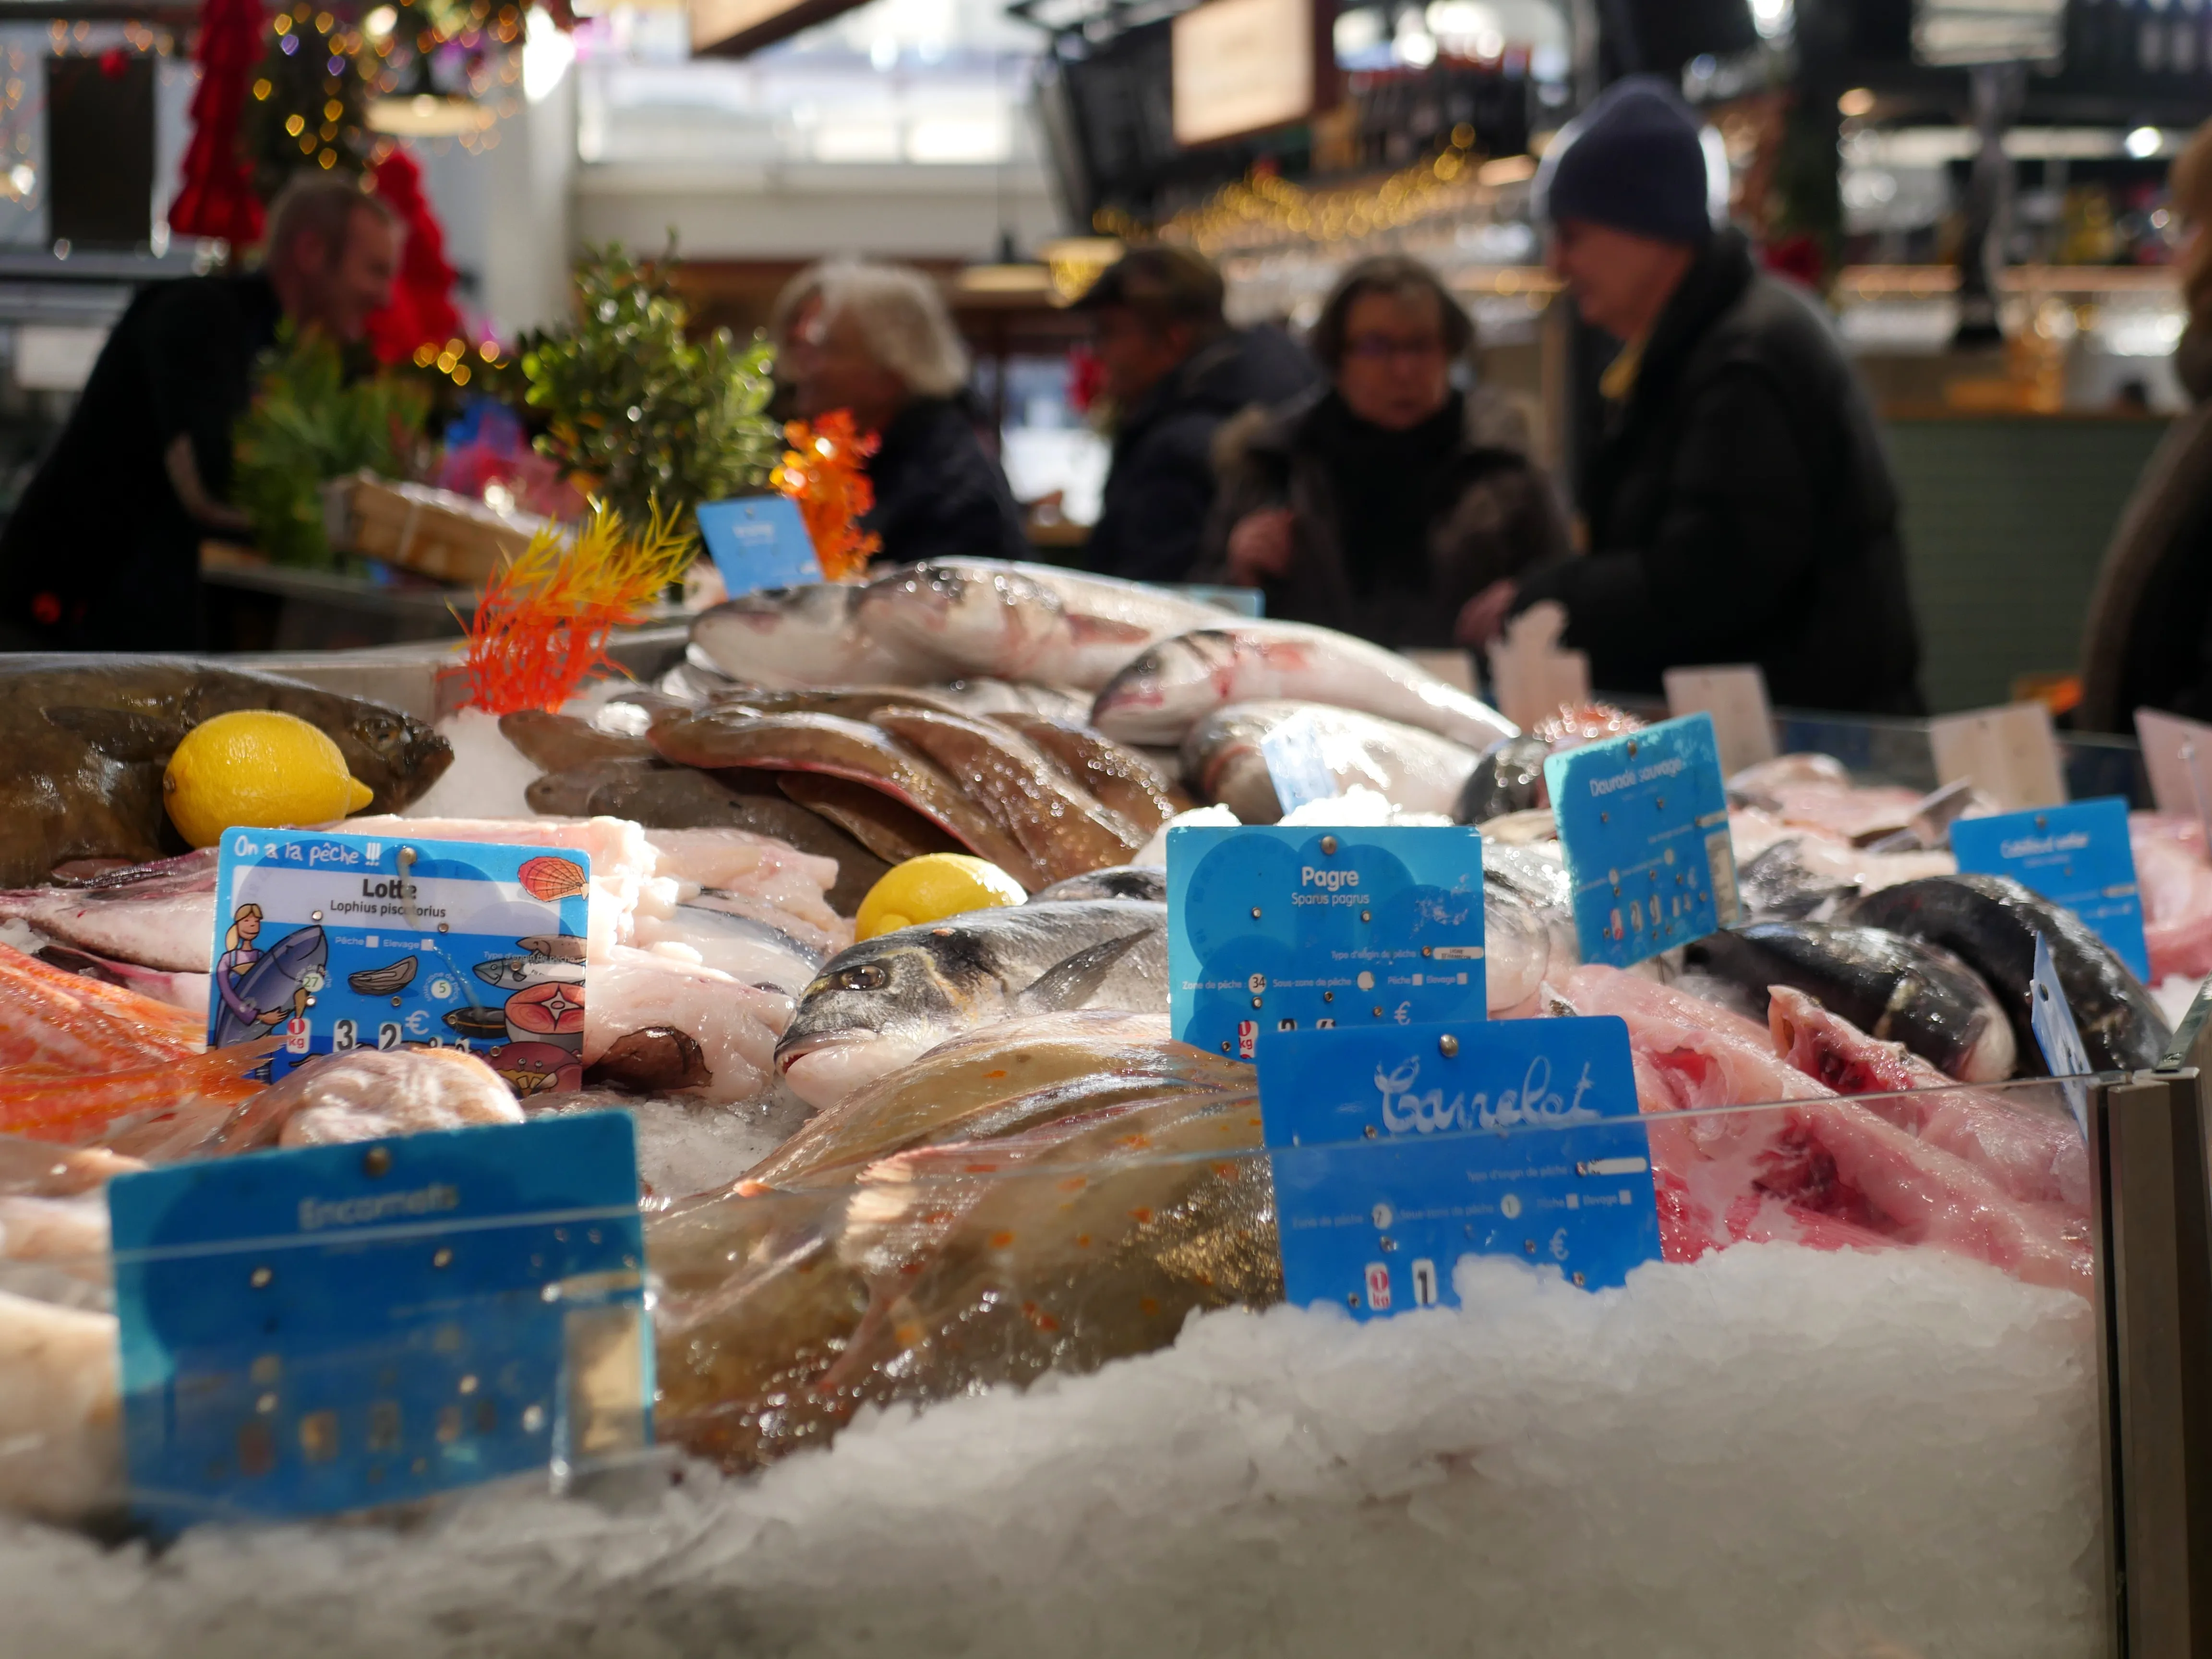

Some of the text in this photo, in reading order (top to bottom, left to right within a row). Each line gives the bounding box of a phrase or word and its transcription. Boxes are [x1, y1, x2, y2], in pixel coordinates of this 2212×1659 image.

[235, 835, 381, 867] On a la pêche !!!
[1302, 866, 1359, 892] Pagre
[362, 878, 417, 900] Lotte
[1291, 892, 1370, 907] Sparus pagrus
[330, 900, 446, 917] Lophius piscorius
[335, 937, 420, 950] Pêche Elevage
[484, 951, 503, 961] Type
[1331, 950, 1348, 960] Type
[304, 976, 319, 987] 27
[439, 982, 446, 994] 5
[1182, 981, 1203, 989] Zone
[1218, 979, 1242, 990] pêche
[1252, 976, 1266, 988] 34
[1328, 977, 1352, 987] pêche
[405, 1010, 430, 1035] €
[337, 1020, 353, 1051] 3
[288, 1038, 304, 1049] kg
[1238, 1037, 1253, 1050] kg
[1549, 1227, 1569, 1261] €
